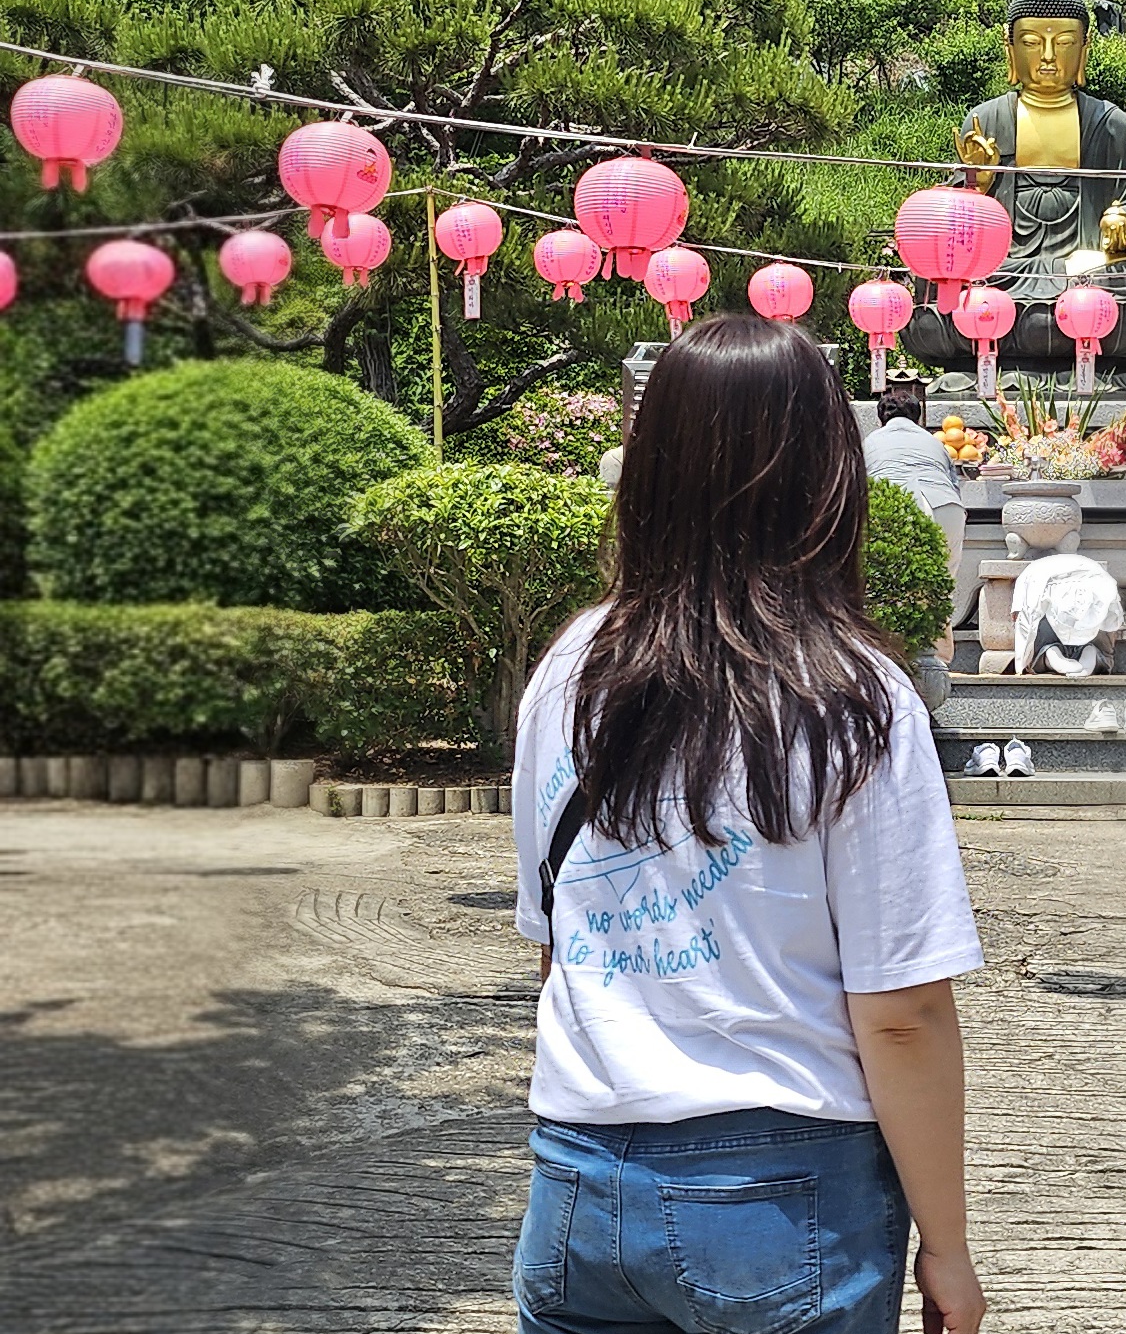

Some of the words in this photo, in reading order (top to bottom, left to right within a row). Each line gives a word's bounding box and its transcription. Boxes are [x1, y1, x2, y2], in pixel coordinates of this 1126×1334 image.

[586, 910, 615, 934] no
[619, 888, 677, 931] words
[681, 825, 753, 911] needed
[567, 930, 594, 965] to
[603, 944, 650, 987] your
